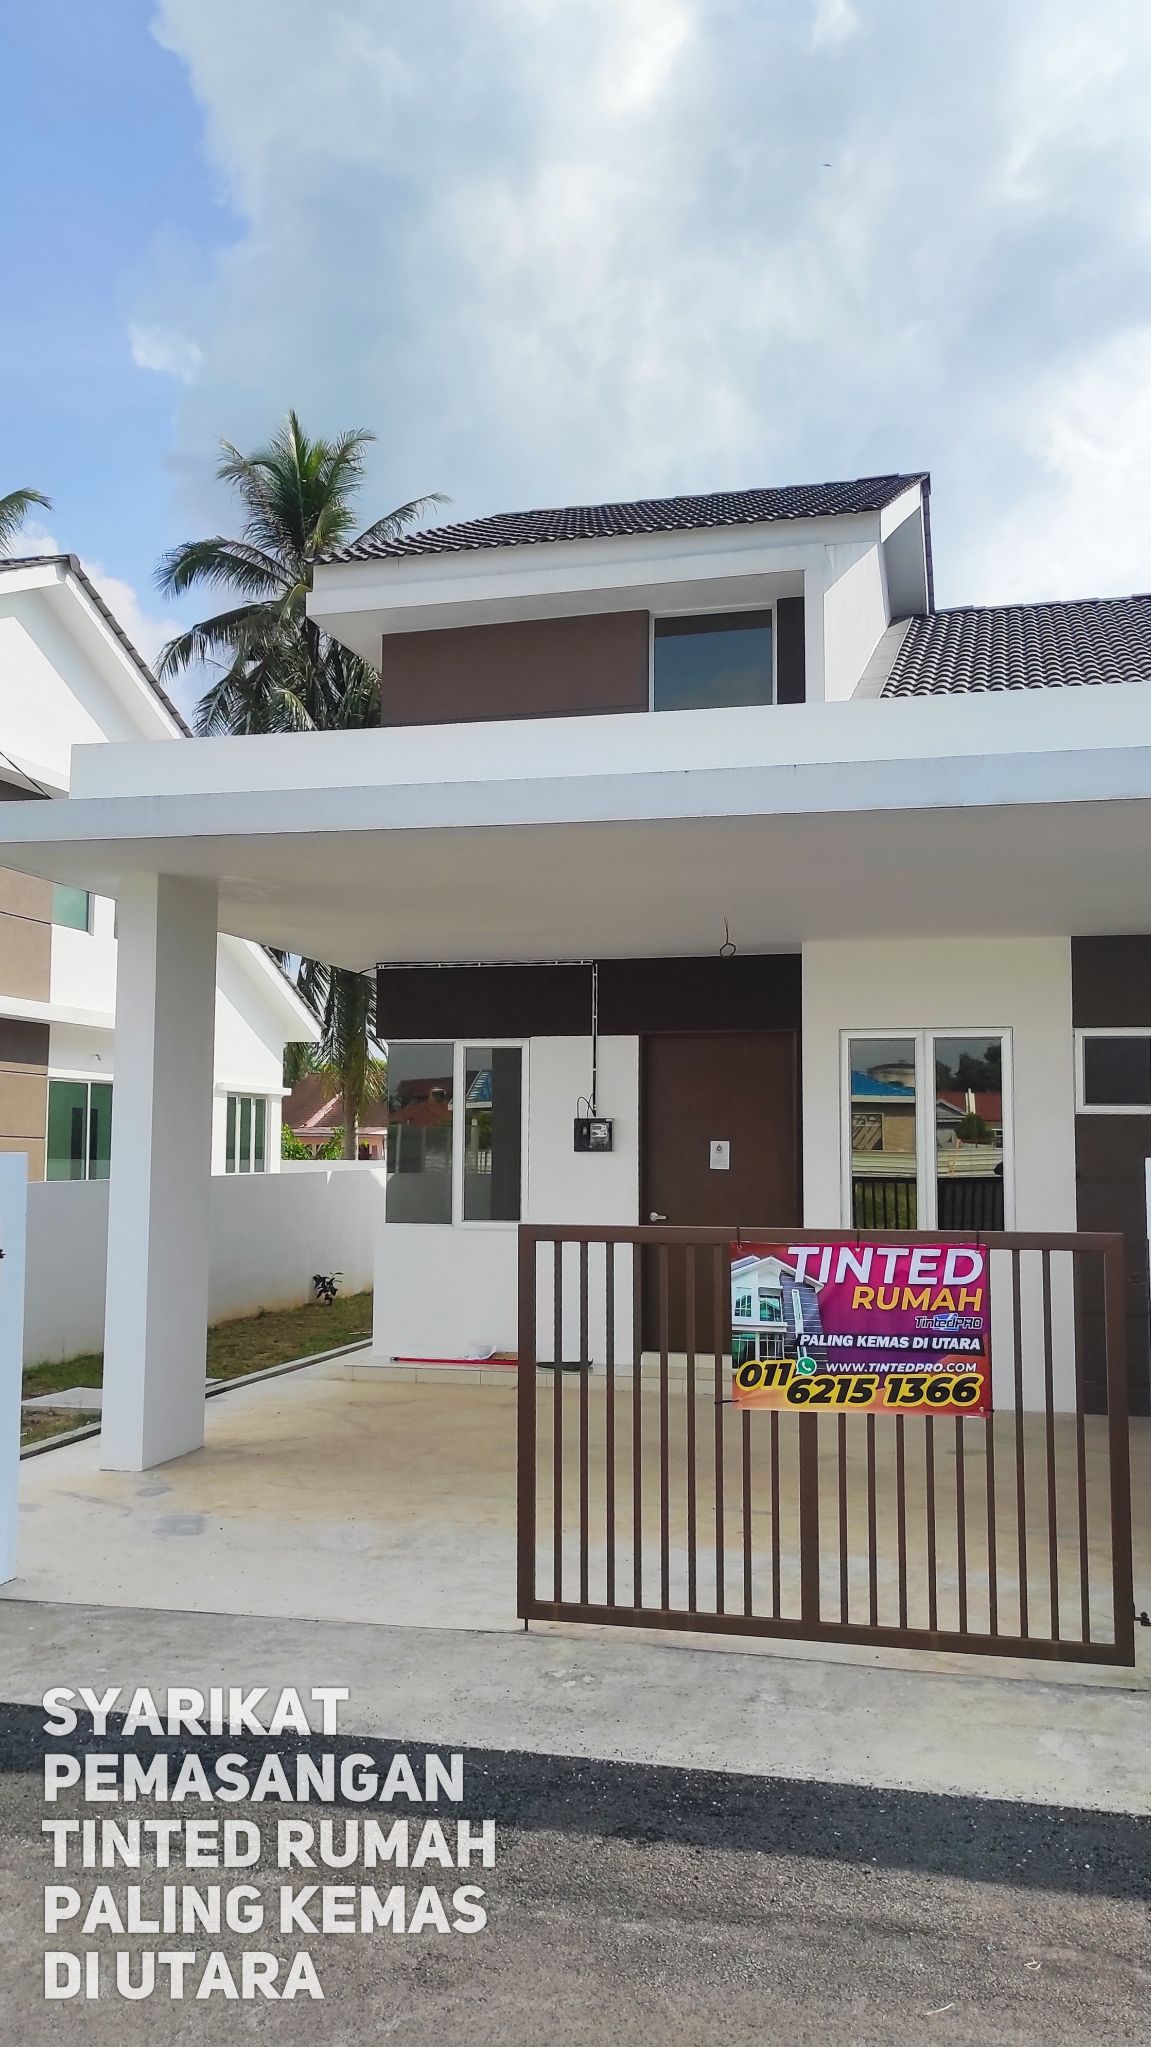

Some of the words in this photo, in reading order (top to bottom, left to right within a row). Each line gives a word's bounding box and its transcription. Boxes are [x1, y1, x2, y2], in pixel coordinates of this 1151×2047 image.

[788, 1246, 984, 1285] TINTED
[852, 1286, 983, 1312] RUMAH
[915, 1315, 983, 1329] TintedPRO
[800, 1335, 853, 1347] PALING
[856, 1336, 909, 1348] KEMAS
[912, 1337, 928, 1349] DI
[931, 1338, 981, 1350] UTARA
[738, 1362, 791, 1387] 011
[826, 1363, 977, 1372] WWW.TINTEDPRO.COM
[787, 1377, 875, 1404] 6215
[886, 1376, 980, 1404] 1366
